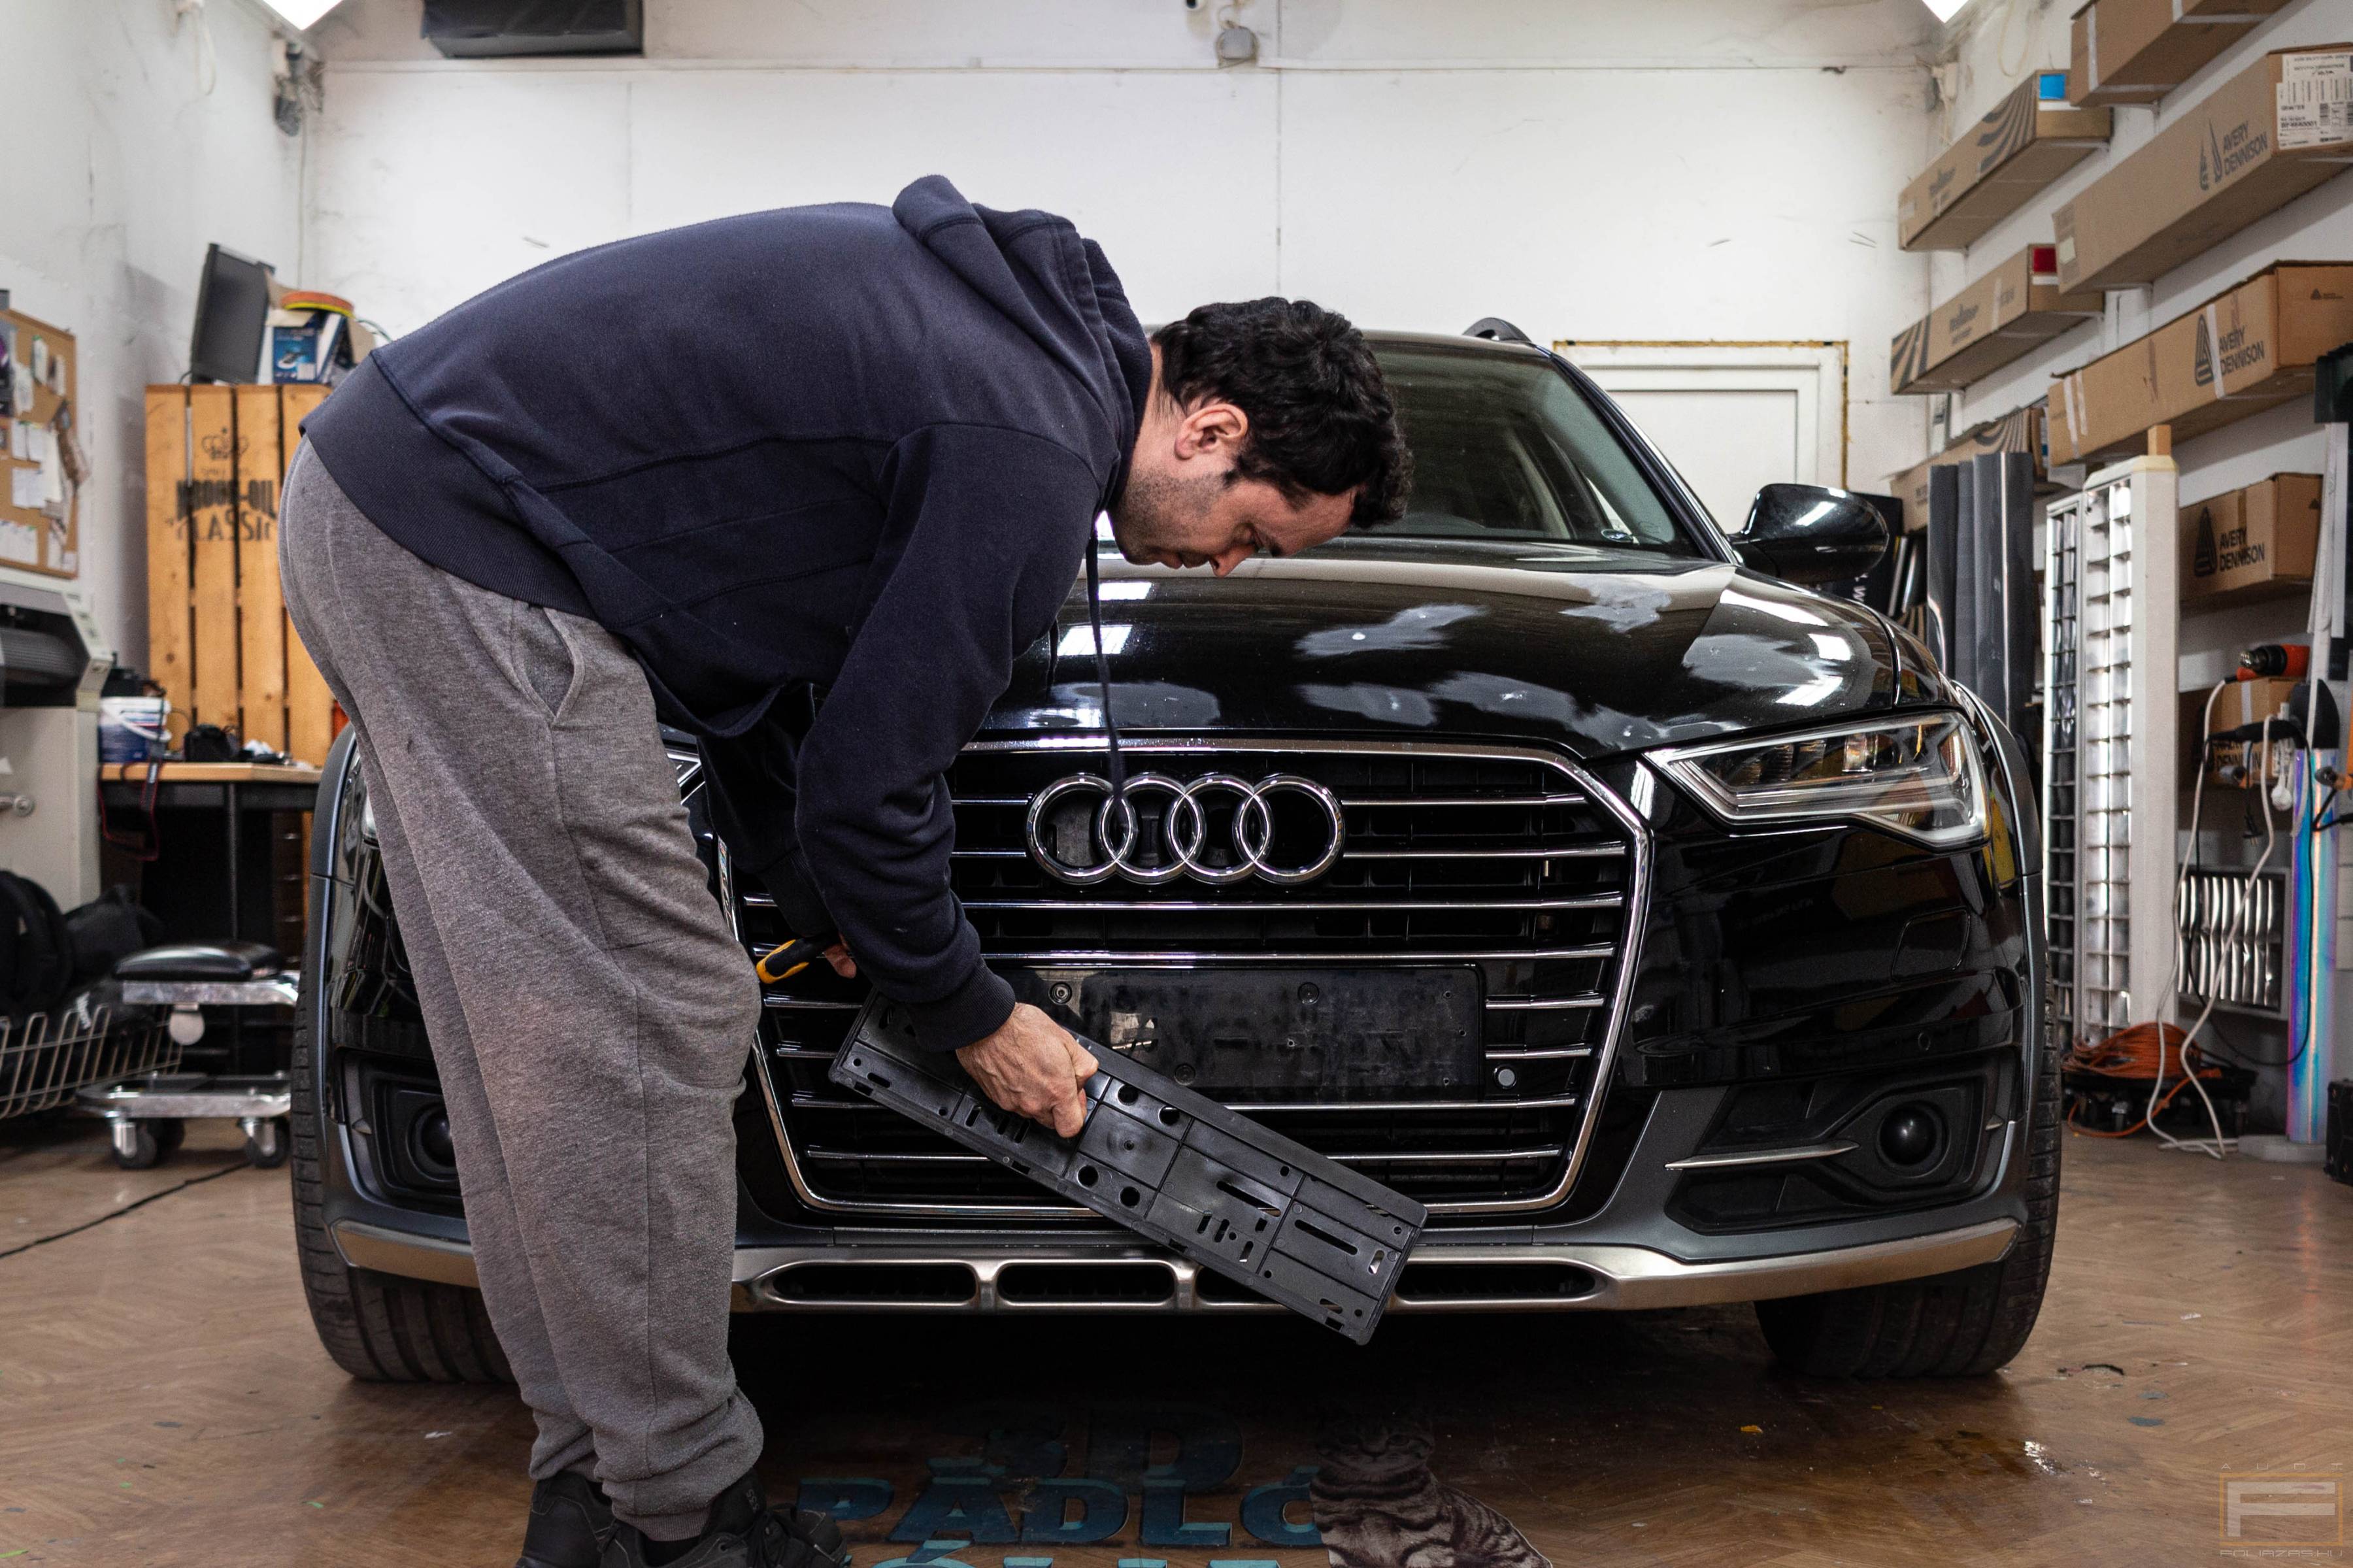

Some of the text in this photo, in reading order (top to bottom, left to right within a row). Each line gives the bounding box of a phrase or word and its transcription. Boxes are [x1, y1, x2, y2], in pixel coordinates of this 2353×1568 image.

[2224, 122, 2248, 152] AVERY
[2224, 133, 2267, 175] DENNISON
[2219, 327, 2246, 354] AVERY
[2220, 341, 2264, 375] DENNISON
[2220, 528, 2247, 550] AVERY
[2220, 544, 2265, 571] DENNISON
